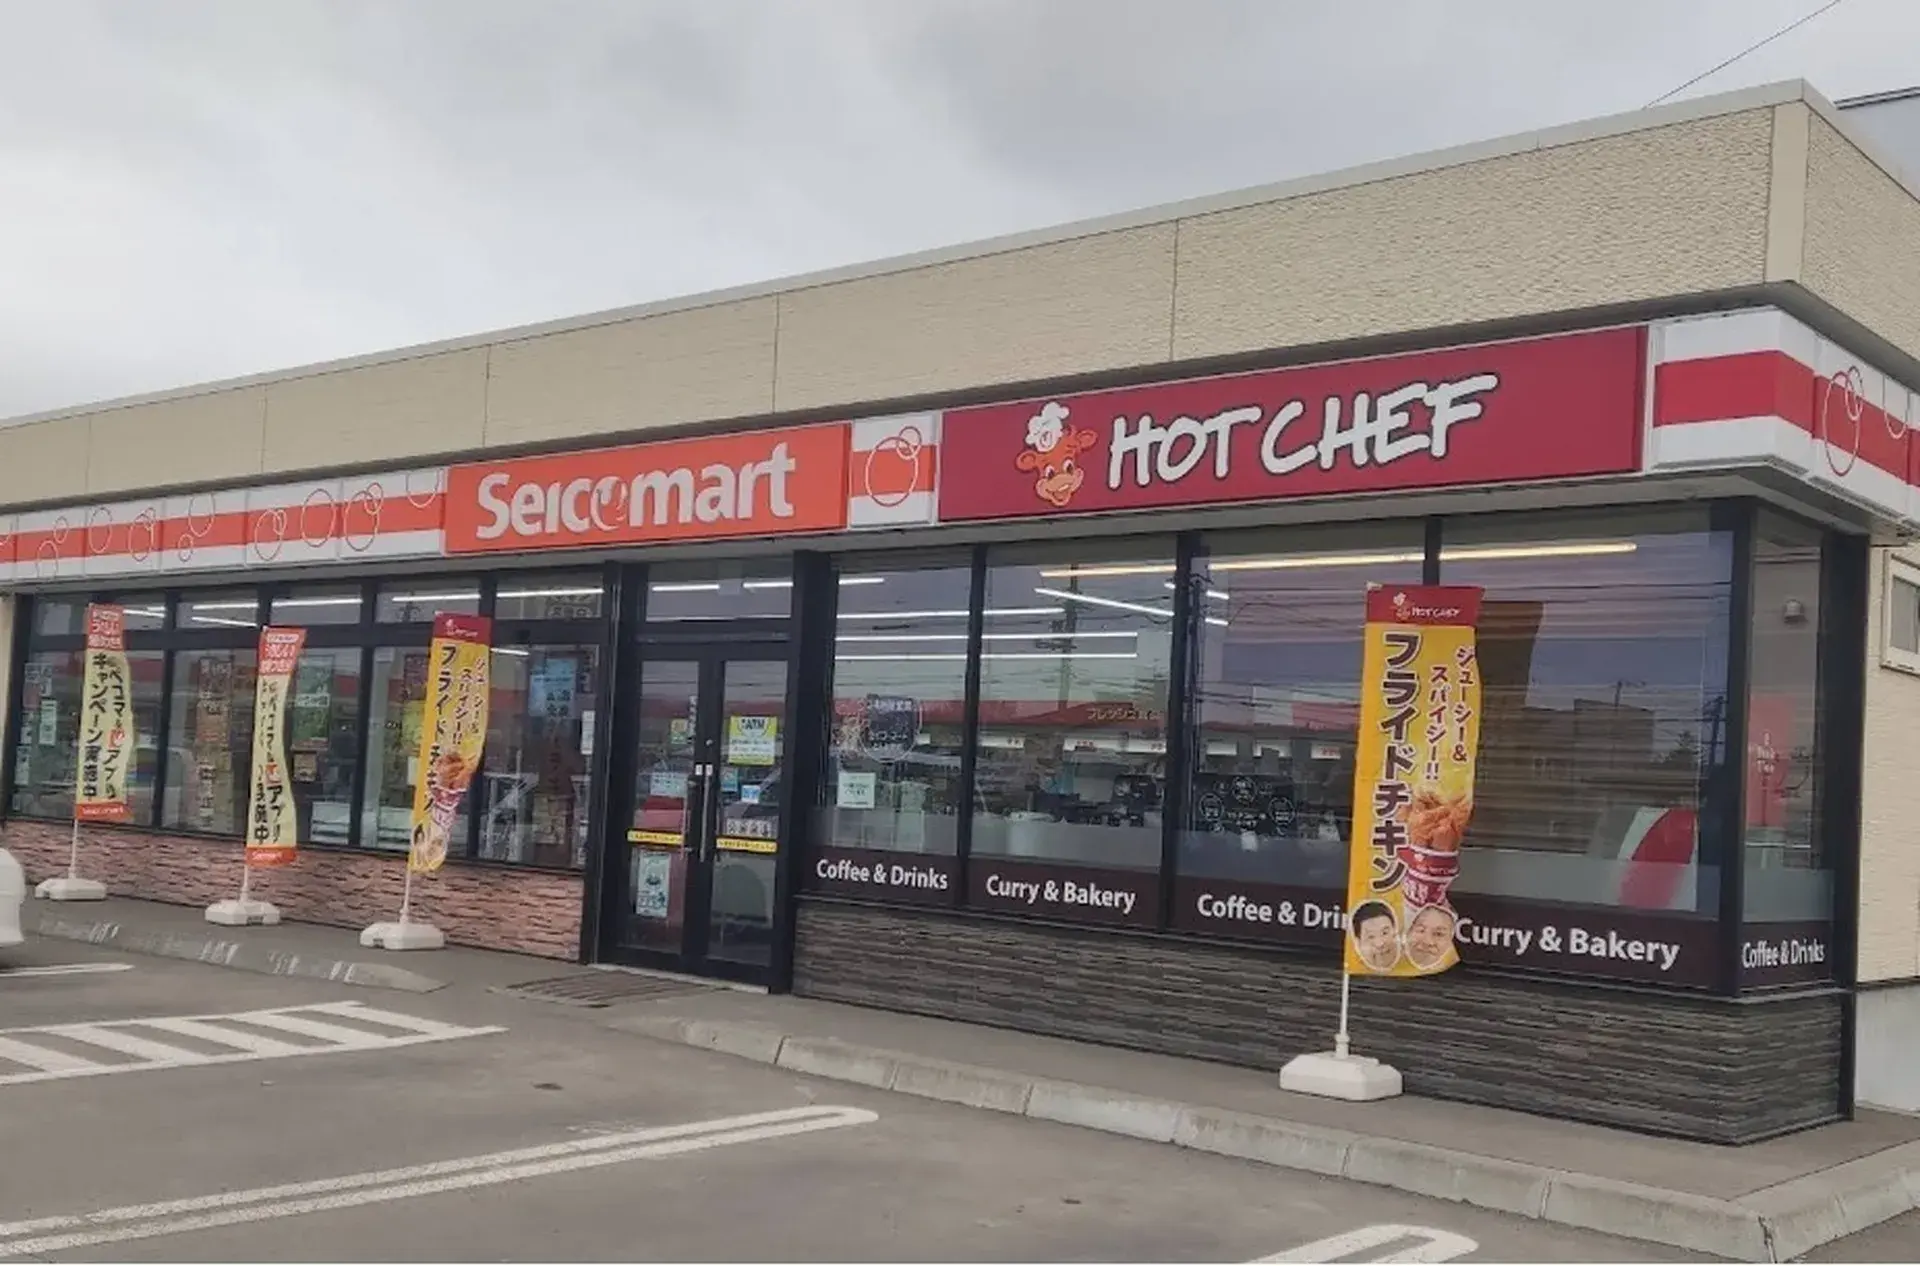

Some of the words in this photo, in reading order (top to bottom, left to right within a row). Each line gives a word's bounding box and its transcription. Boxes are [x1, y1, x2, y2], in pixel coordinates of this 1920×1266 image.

[1107, 405, 1263, 490] HOT
[1261, 373, 1499, 475] CHEF
[475, 441, 796, 540] Seicomart
[1426, 666, 1451, 780] スパイシー!!
[1453, 647, 1475, 762] ジューシー&
[1372, 633, 1421, 890] フライドチキン
[816, 858, 869, 883] Coffee
[873, 863, 886, 884] &
[891, 865, 948, 890] Drinks
[986, 875, 1040, 904] Curry
[1044, 880, 1059, 902] &
[1064, 881, 1136, 915] Bakery
[1197, 893, 1273, 922] Coffee
[1277, 901, 1297, 925] &
[1455, 917, 1534, 955] Curry
[1539, 926, 1563, 953] &
[1568, 928, 1680, 971] Bakery
[1742, 939, 1778, 968] Coffee
[1780, 939, 1790, 965] &
[1791, 938, 1825, 964] Drinks
